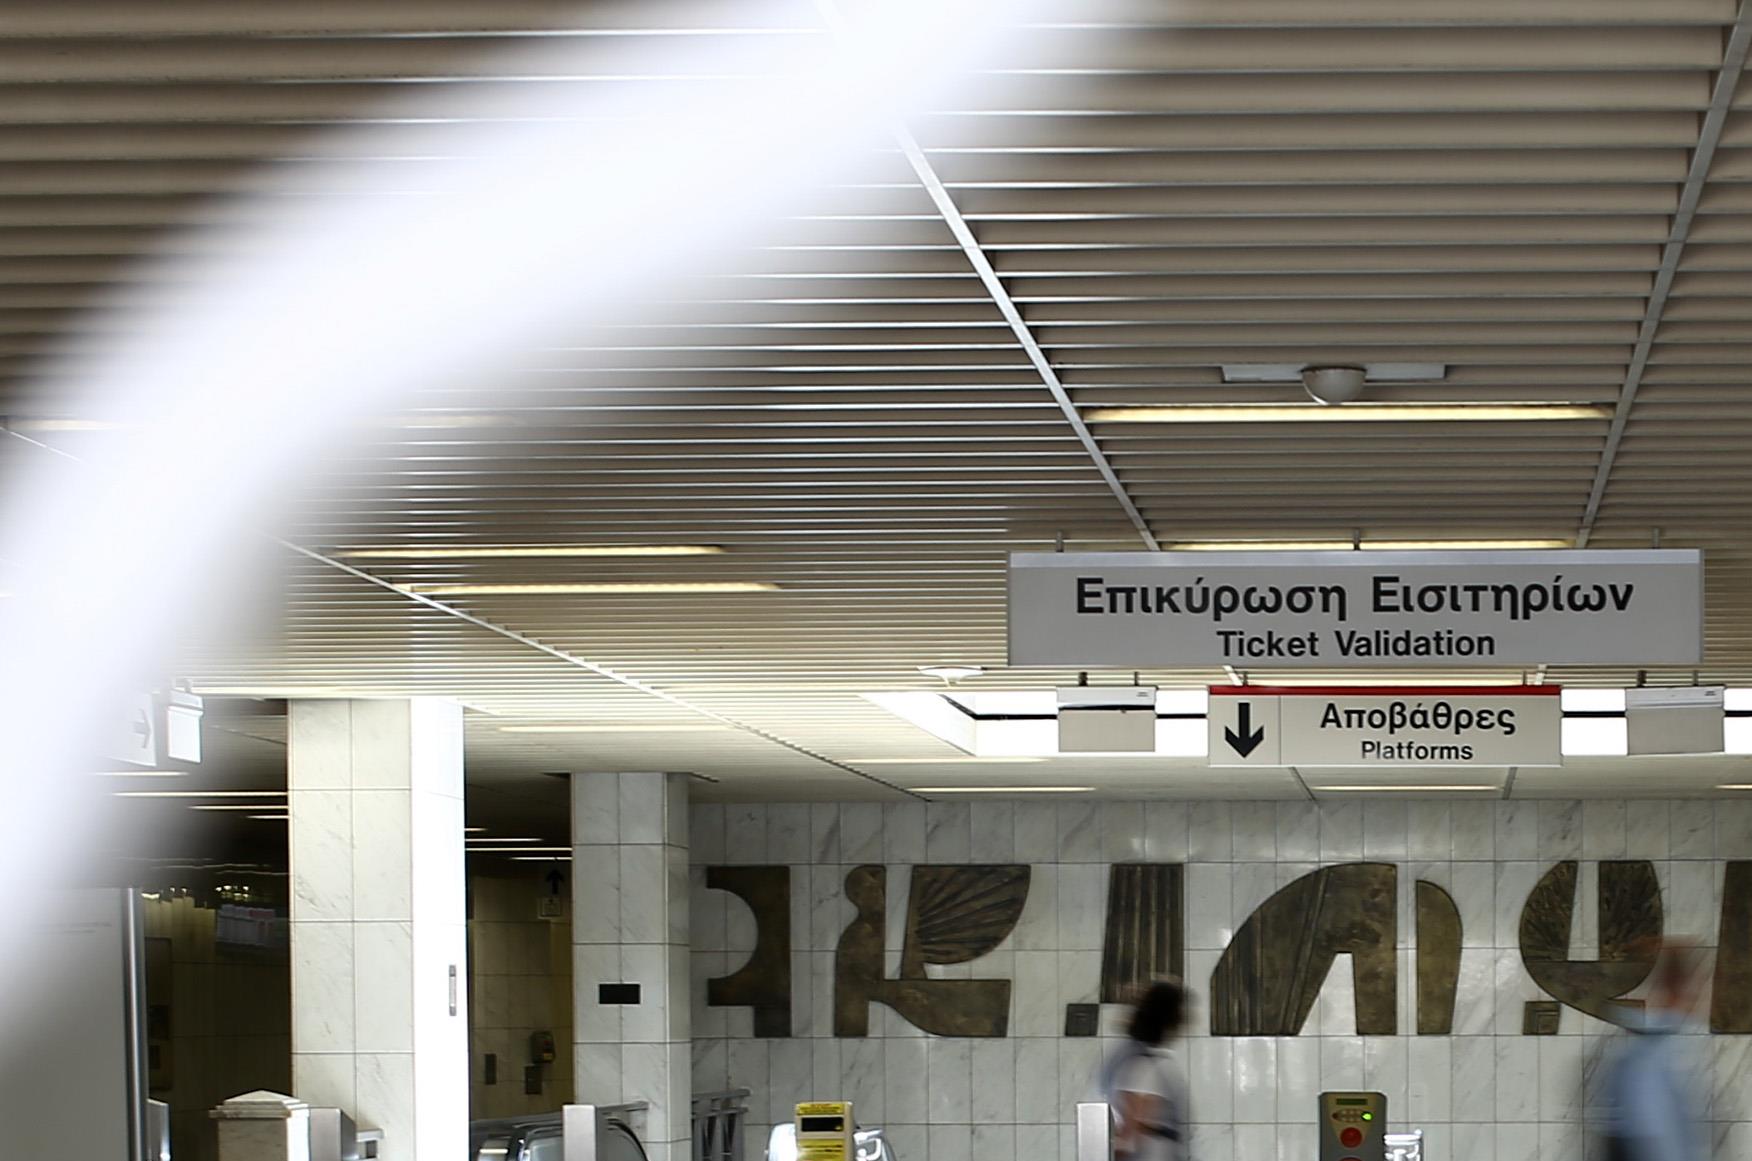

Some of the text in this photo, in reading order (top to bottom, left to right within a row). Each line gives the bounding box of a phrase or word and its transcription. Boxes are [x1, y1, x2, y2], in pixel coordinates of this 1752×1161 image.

[1077, 575, 1634, 621] Επικύρωση Εισιτηρίων
[1216, 629, 1494, 657] Ticket Validation
[1320, 702, 1515, 735] Αποβάθρες
[1362, 741, 1473, 760] Platforms
